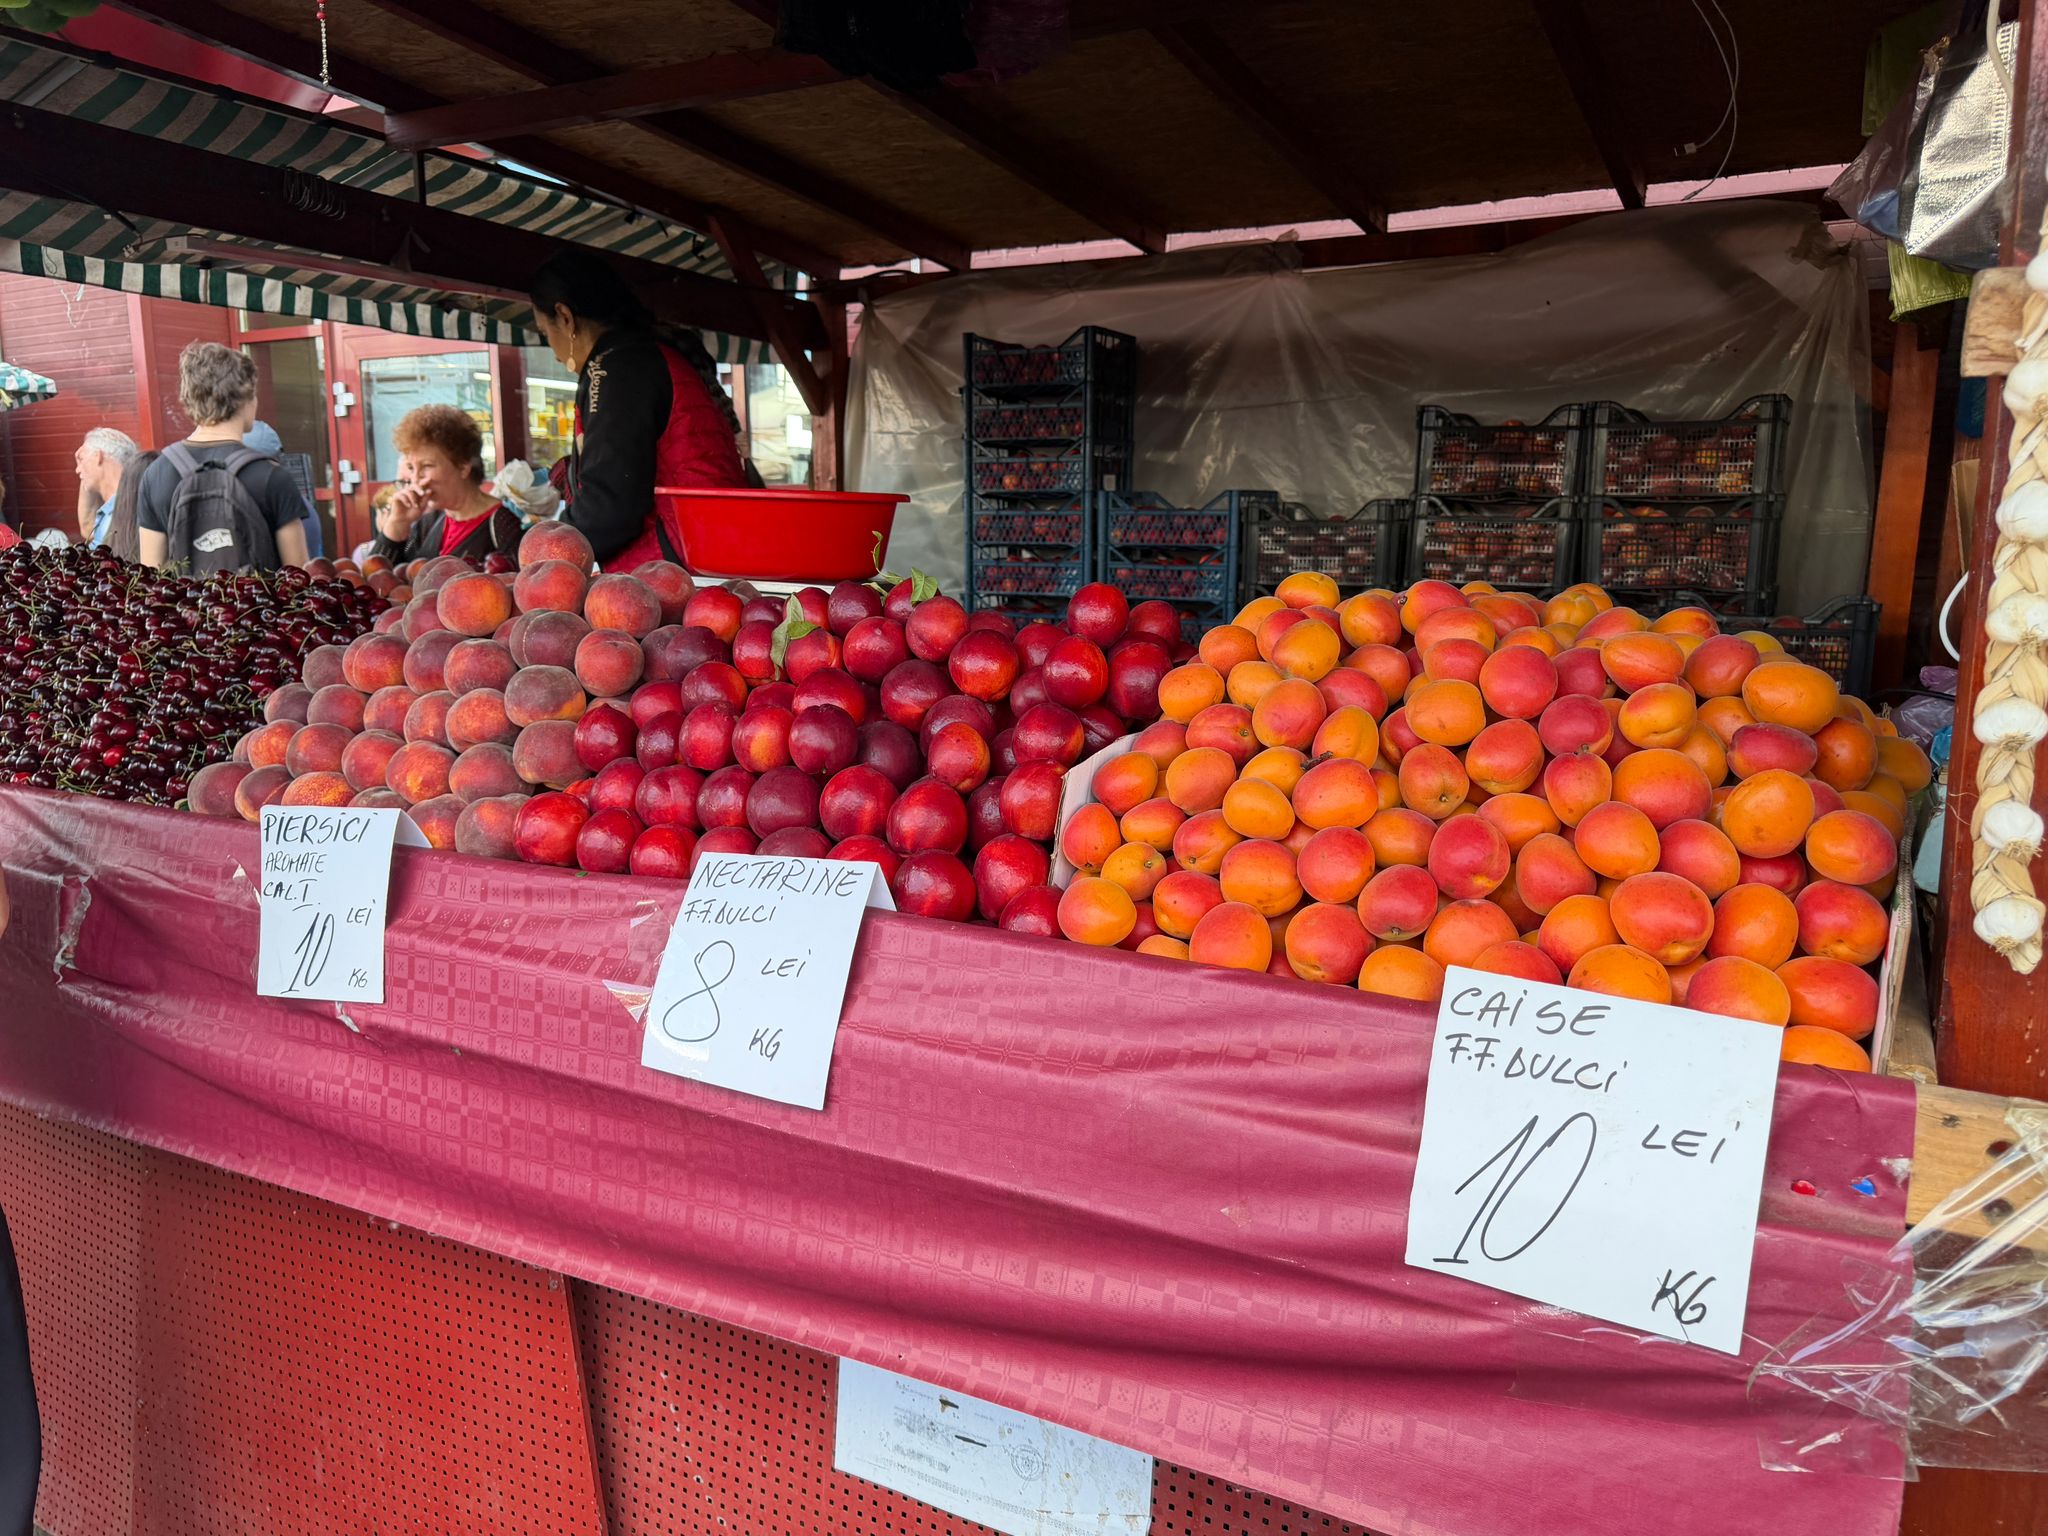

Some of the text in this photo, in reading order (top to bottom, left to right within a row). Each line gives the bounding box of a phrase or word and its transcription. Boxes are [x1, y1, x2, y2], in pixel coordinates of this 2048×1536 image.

[265, 851, 327, 873] AROMATE
[694, 859, 863, 896] NECTARINE
[280, 899, 376, 994] 10 LEI
[348, 969, 368, 988] KG
[662, 940, 812, 1042] 8 LEI
[748, 1027, 783, 1061] KG
[1432, 1111, 1741, 1264] 10 LEI
[1651, 1268, 1717, 1324] KG
